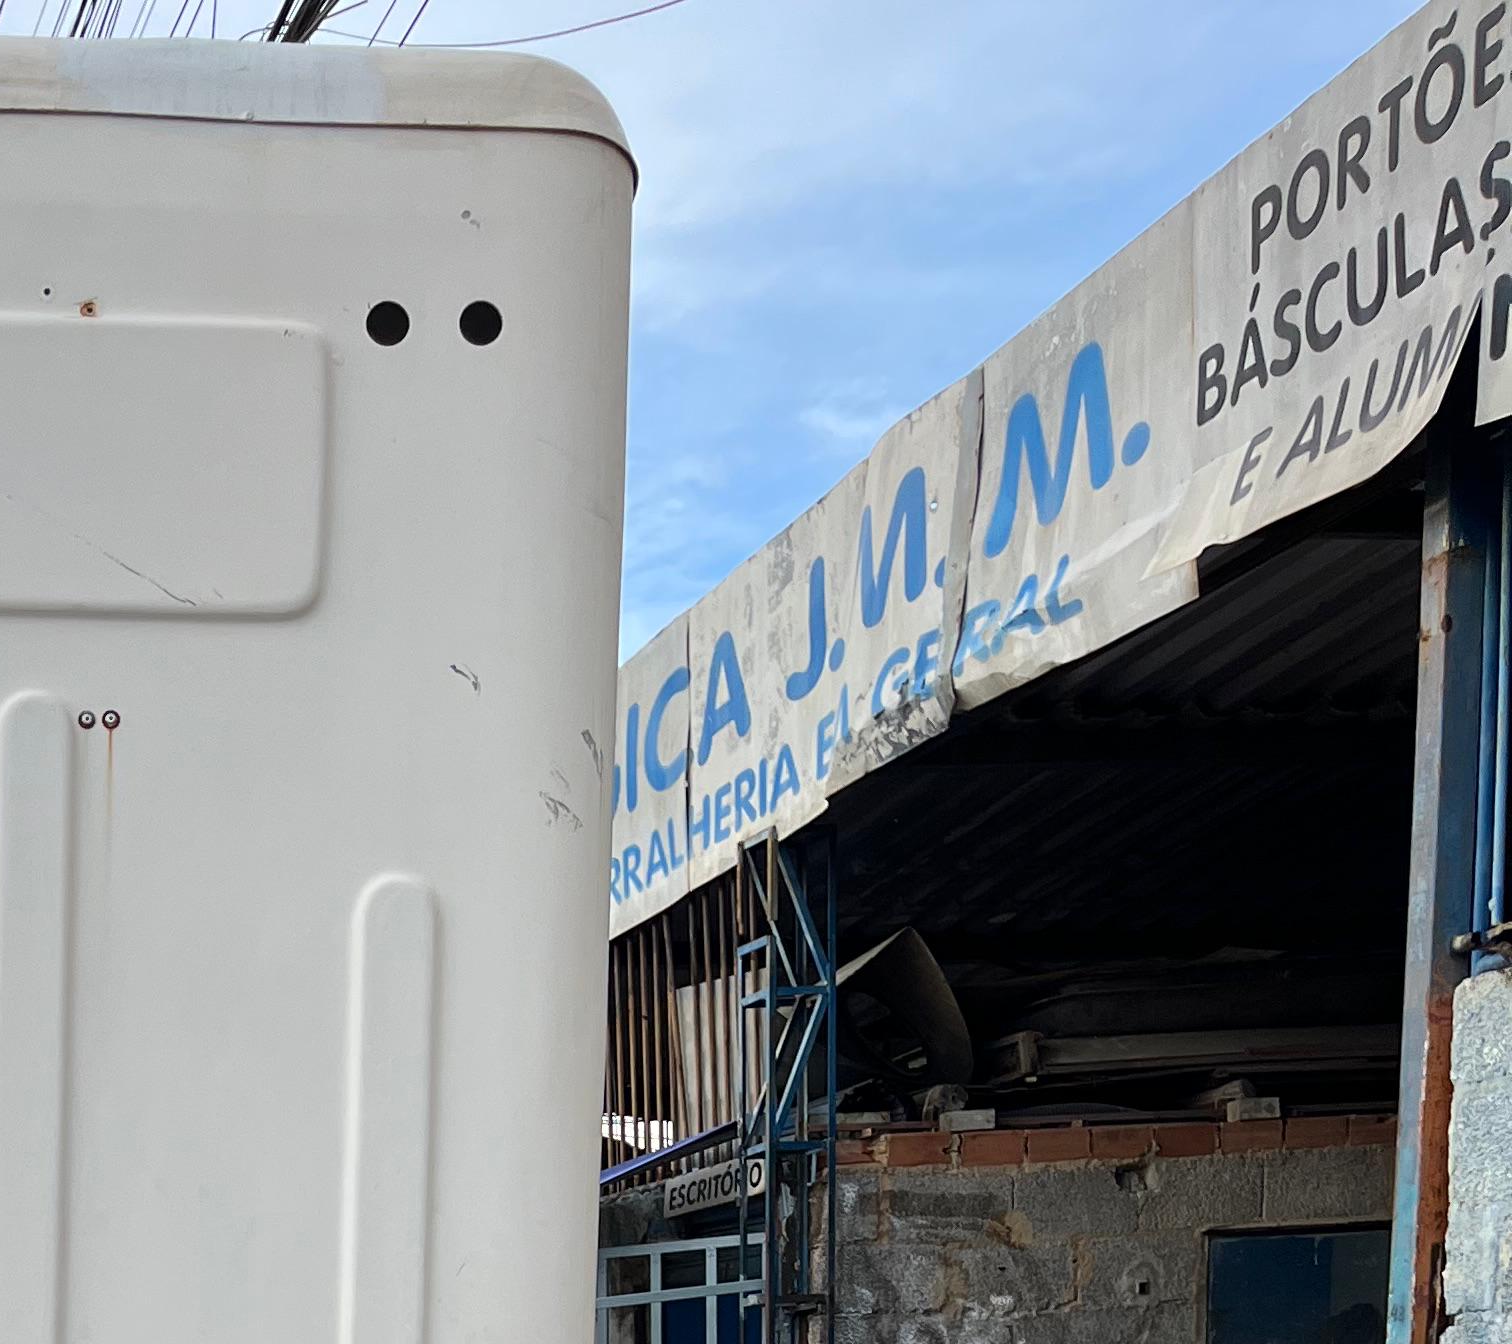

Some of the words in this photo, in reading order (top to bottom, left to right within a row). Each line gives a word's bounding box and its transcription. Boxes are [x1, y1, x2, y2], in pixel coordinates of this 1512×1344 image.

[1250, 2, 1512, 274] PORTÕE
[1196, 141, 1512, 427] BÁSCULAS
[1230, 426, 1273, 507] E
[1276, 248, 1512, 480] ALUM
[612, 631, 752, 816] ICA
[786, 555, 845, 701] J.
[984, 341, 1151, 559] M.
[669, 1162, 762, 1211] ESCRITÓRO
